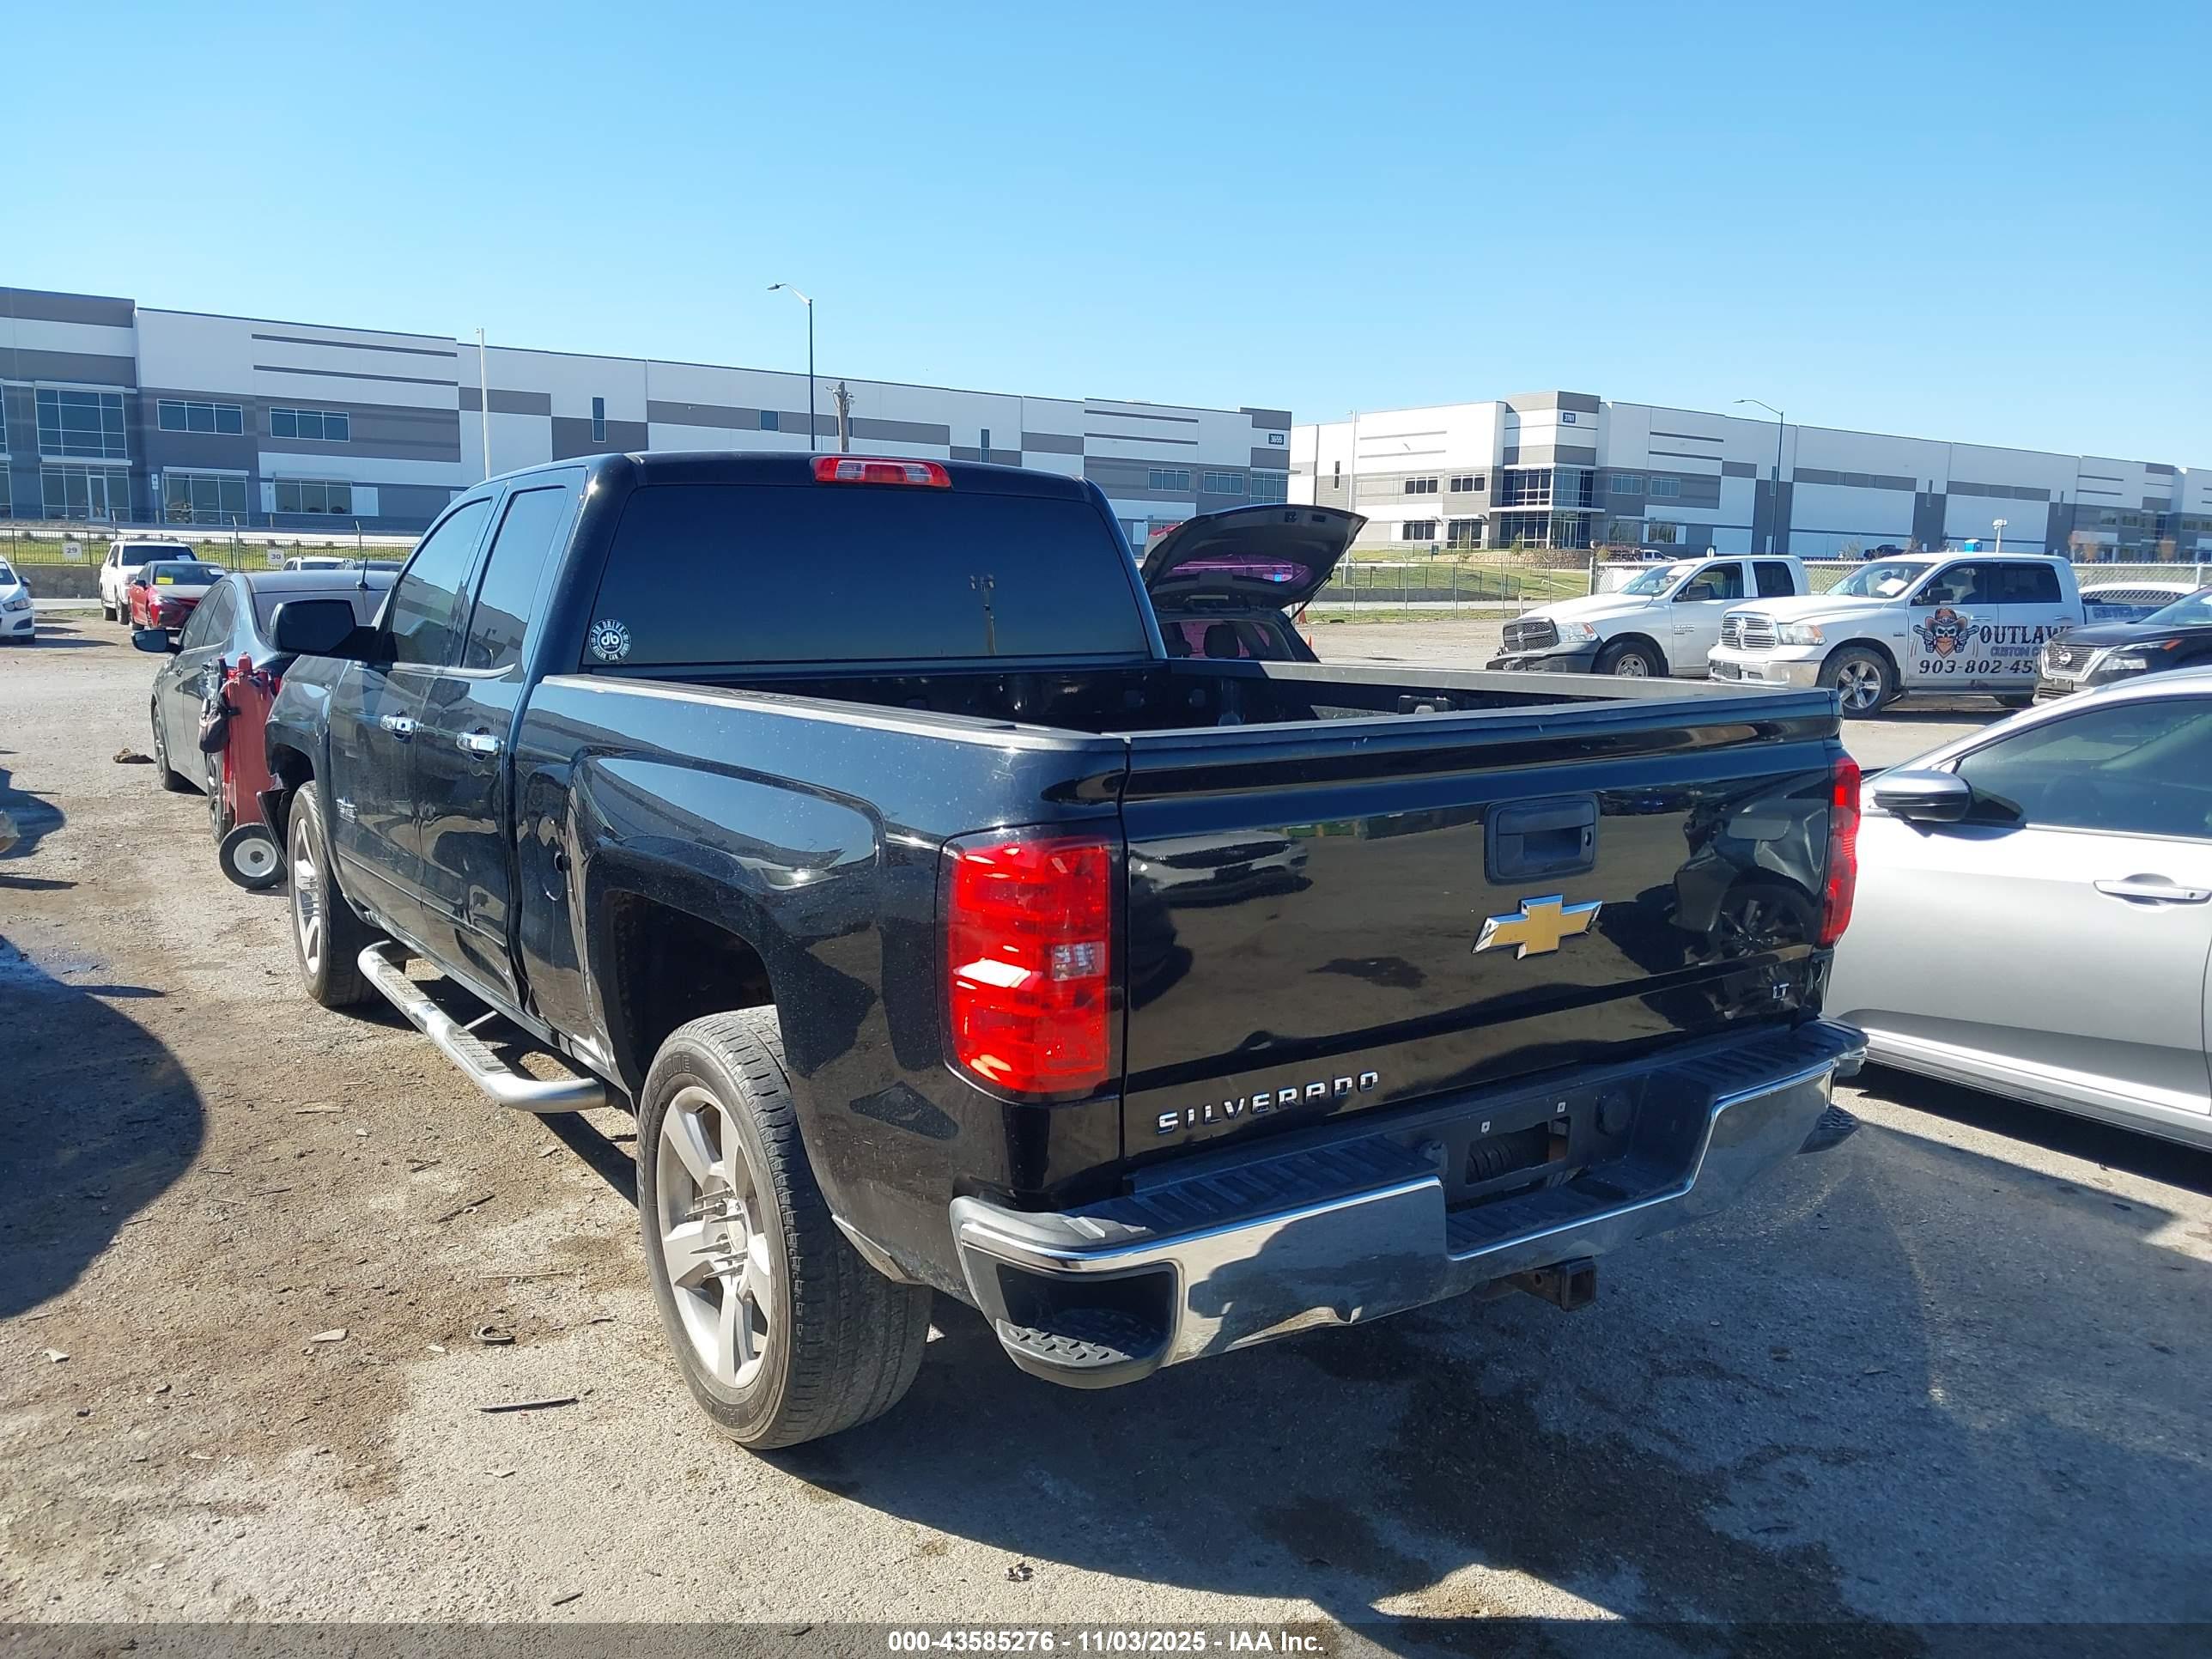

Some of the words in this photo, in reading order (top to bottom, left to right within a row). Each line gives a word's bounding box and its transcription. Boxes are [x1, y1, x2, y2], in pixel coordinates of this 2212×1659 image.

[1979, 625, 2075, 644] OUTLAW
[1919, 660, 2039, 674] 903-802-45
[1772, 982, 1790, 1000] LT
[1156, 1071, 1379, 1134] SILVERADO
